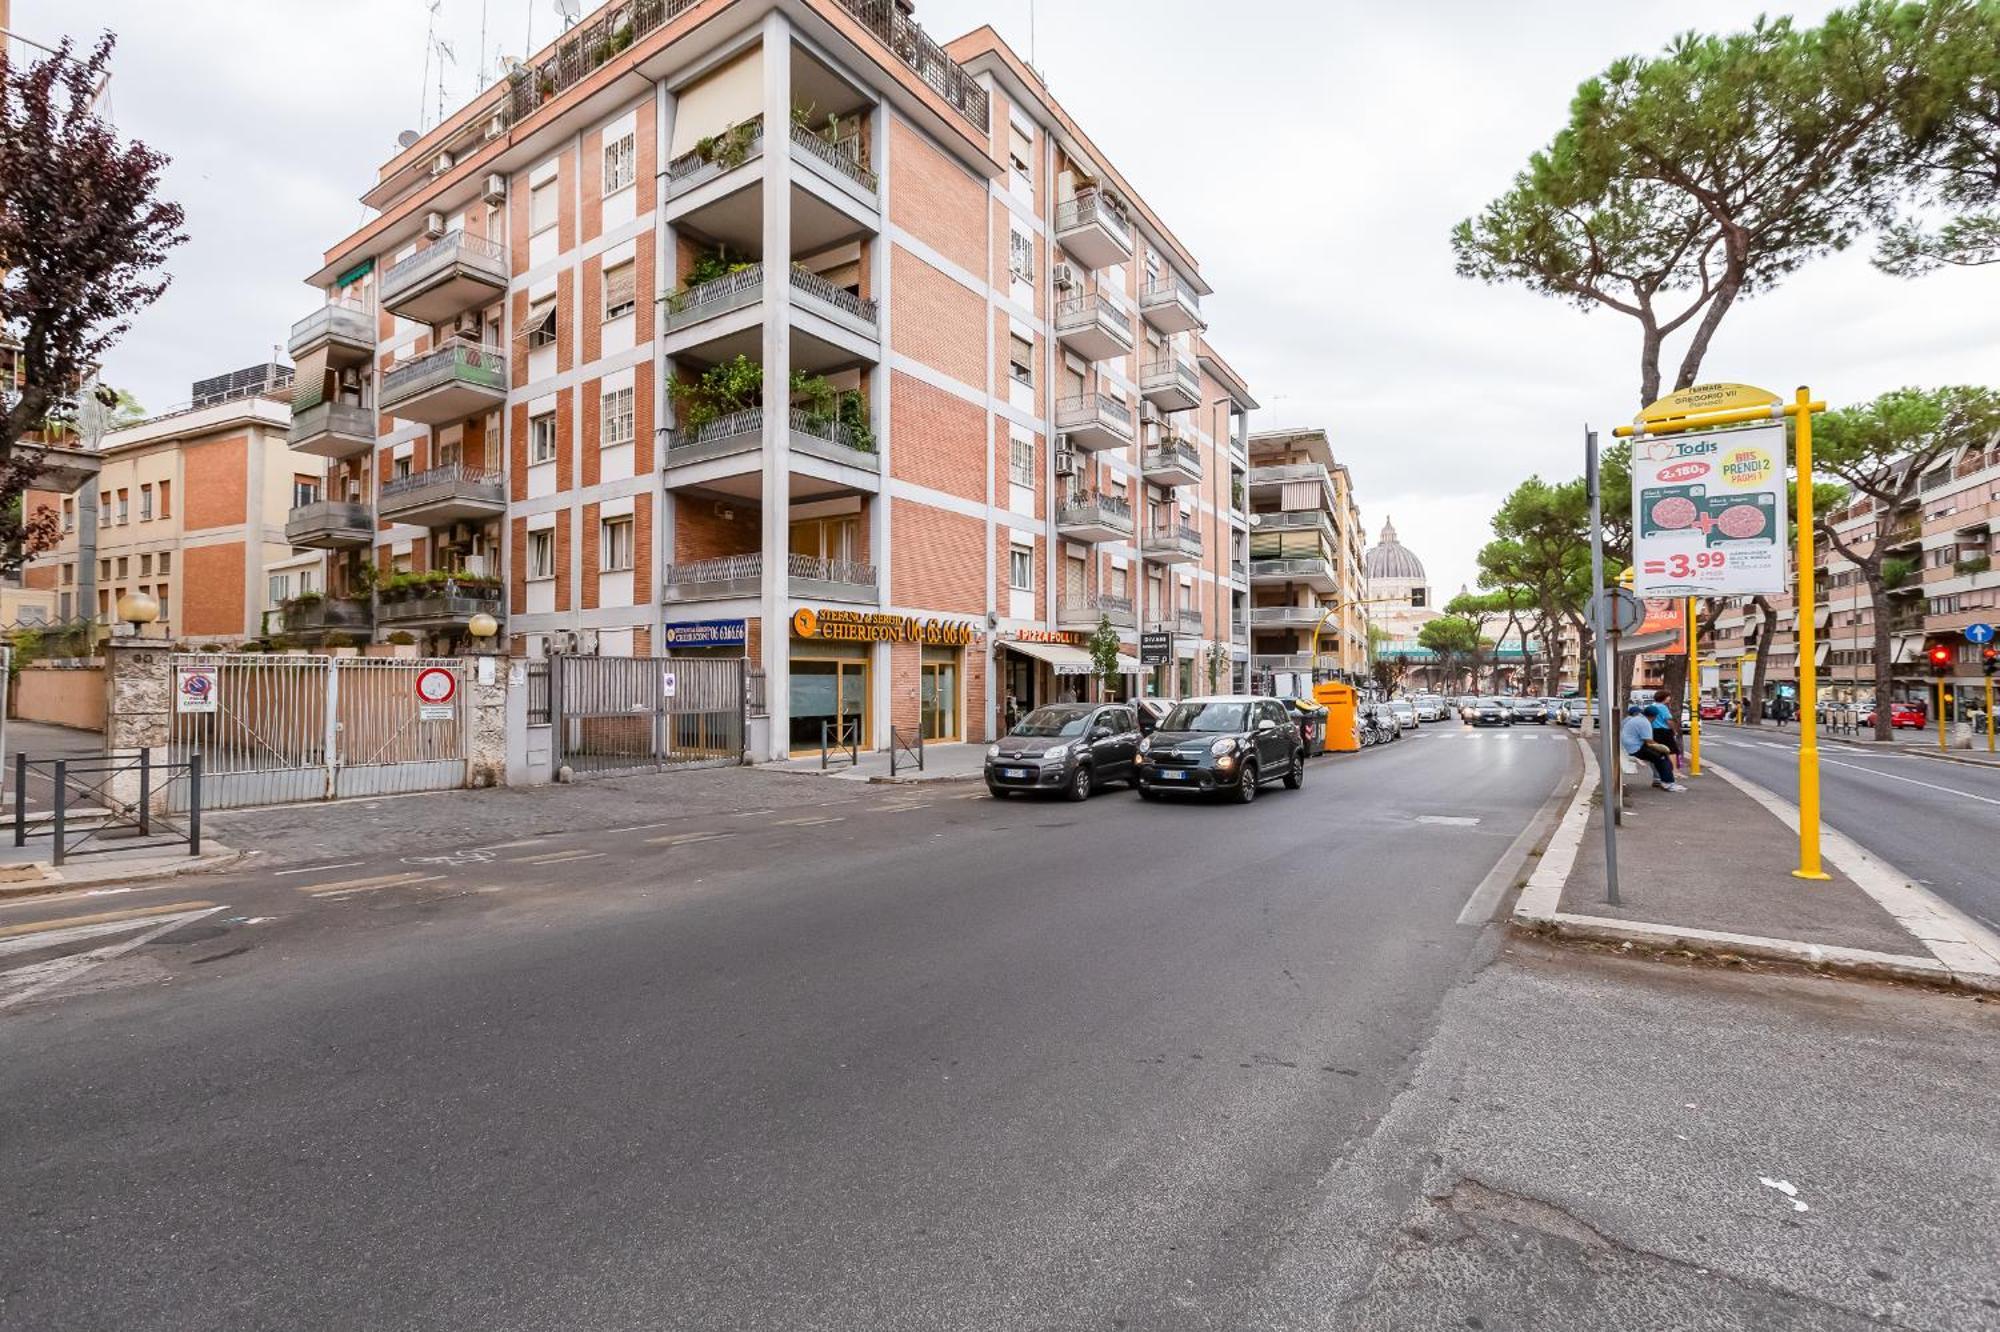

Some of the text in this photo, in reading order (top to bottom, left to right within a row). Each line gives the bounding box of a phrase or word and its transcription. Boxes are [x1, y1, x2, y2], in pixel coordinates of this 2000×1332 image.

[1675, 391, 1723, 405] GREGORIO
[1726, 390, 1737, 398] VII
[1676, 441, 1717, 455] Todis
[1723, 459, 1770, 475] PRENDI 2
[818, 609, 861, 622] STEFANO
[872, 613, 903, 625] SERGIO
[904, 617, 920, 641] 06
[822, 622, 902, 641] CHIERICONI
[1022, 629, 1049, 642] PIZZA
